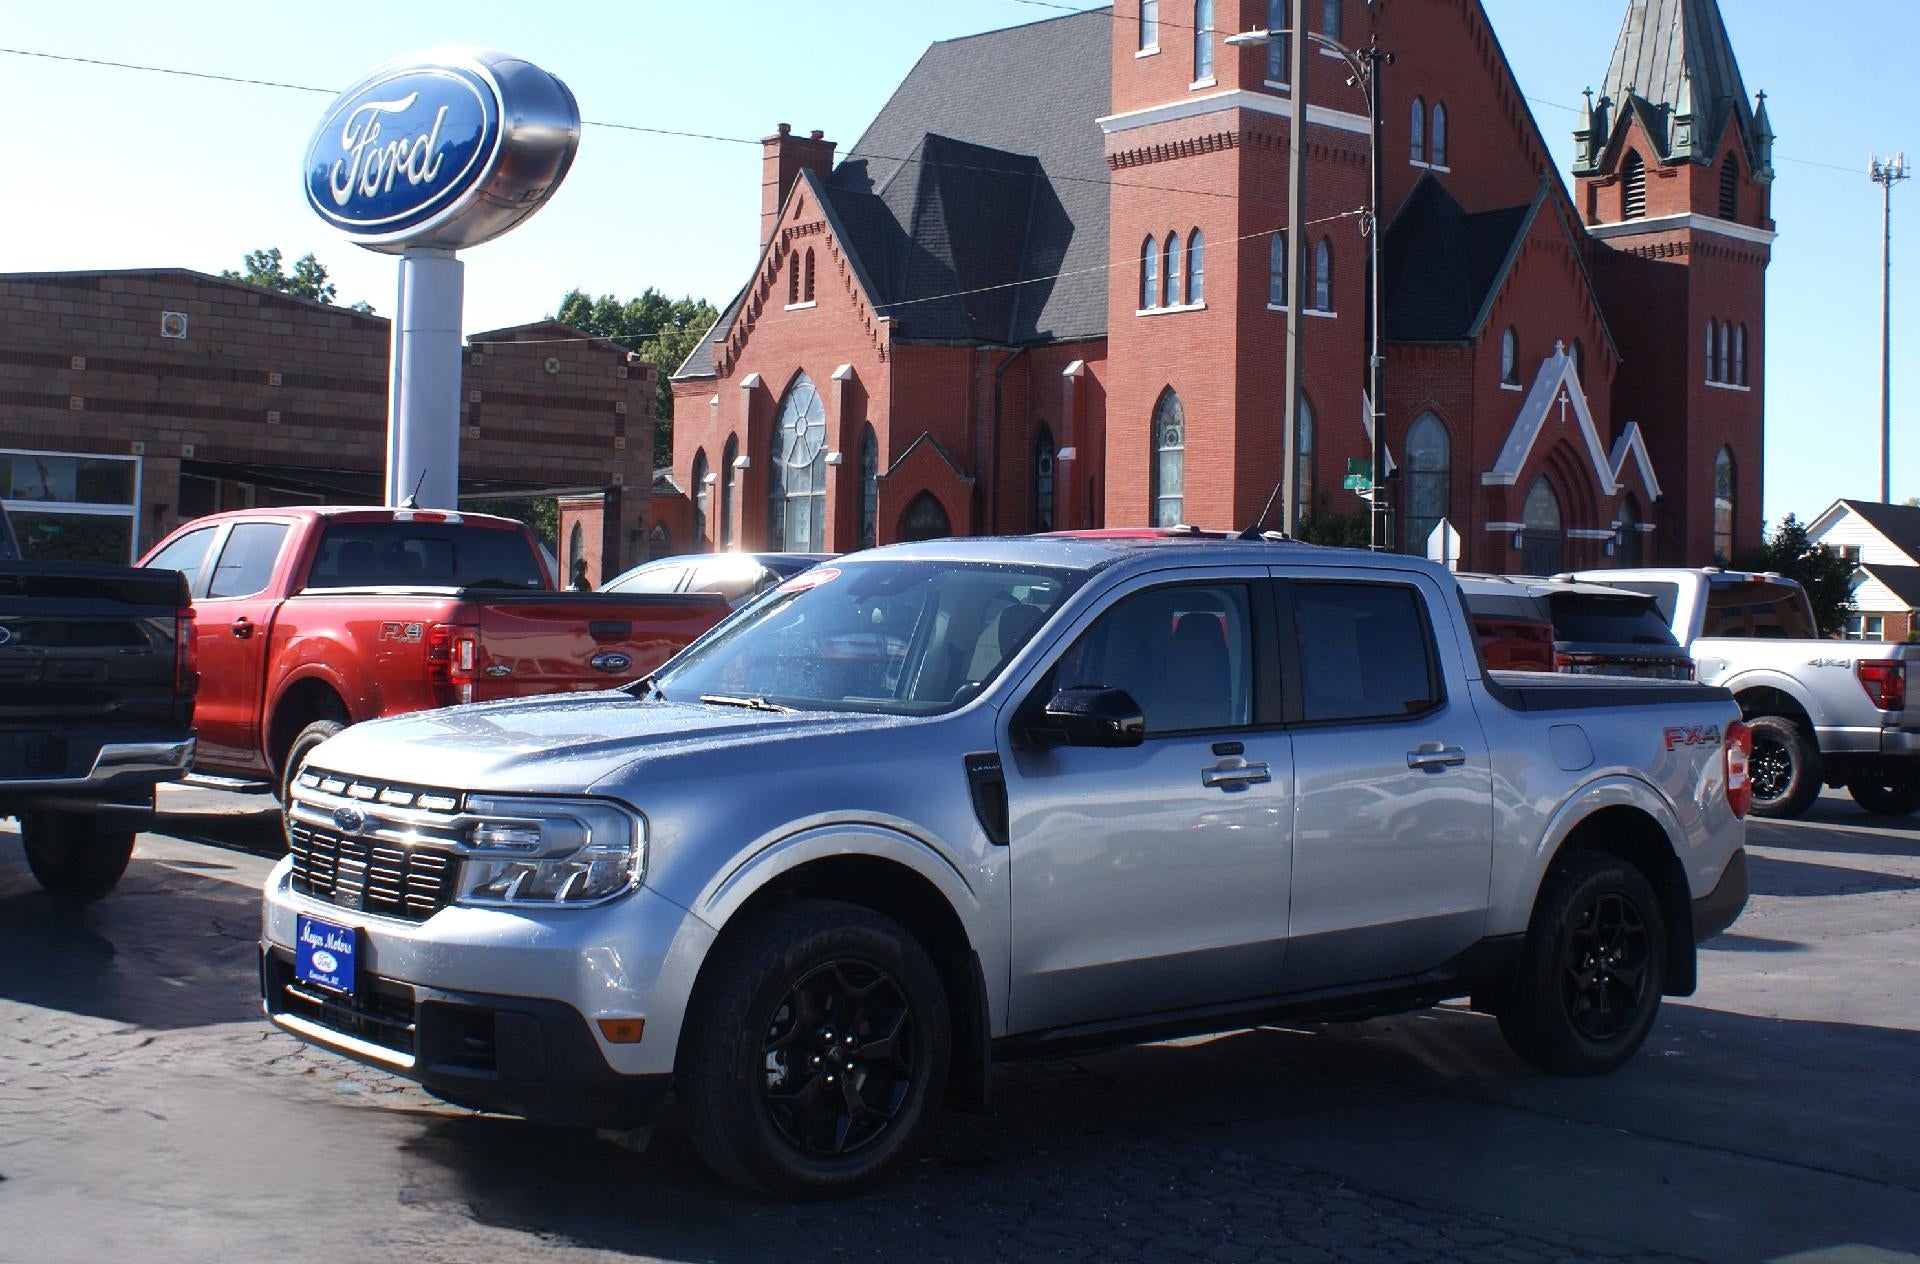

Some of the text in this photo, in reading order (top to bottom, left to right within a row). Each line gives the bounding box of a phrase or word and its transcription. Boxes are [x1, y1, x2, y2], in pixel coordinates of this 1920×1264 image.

[331, 91, 449, 206] Ford
[378, 621, 424, 643] FX4
[1664, 724, 1721, 751] FX4
